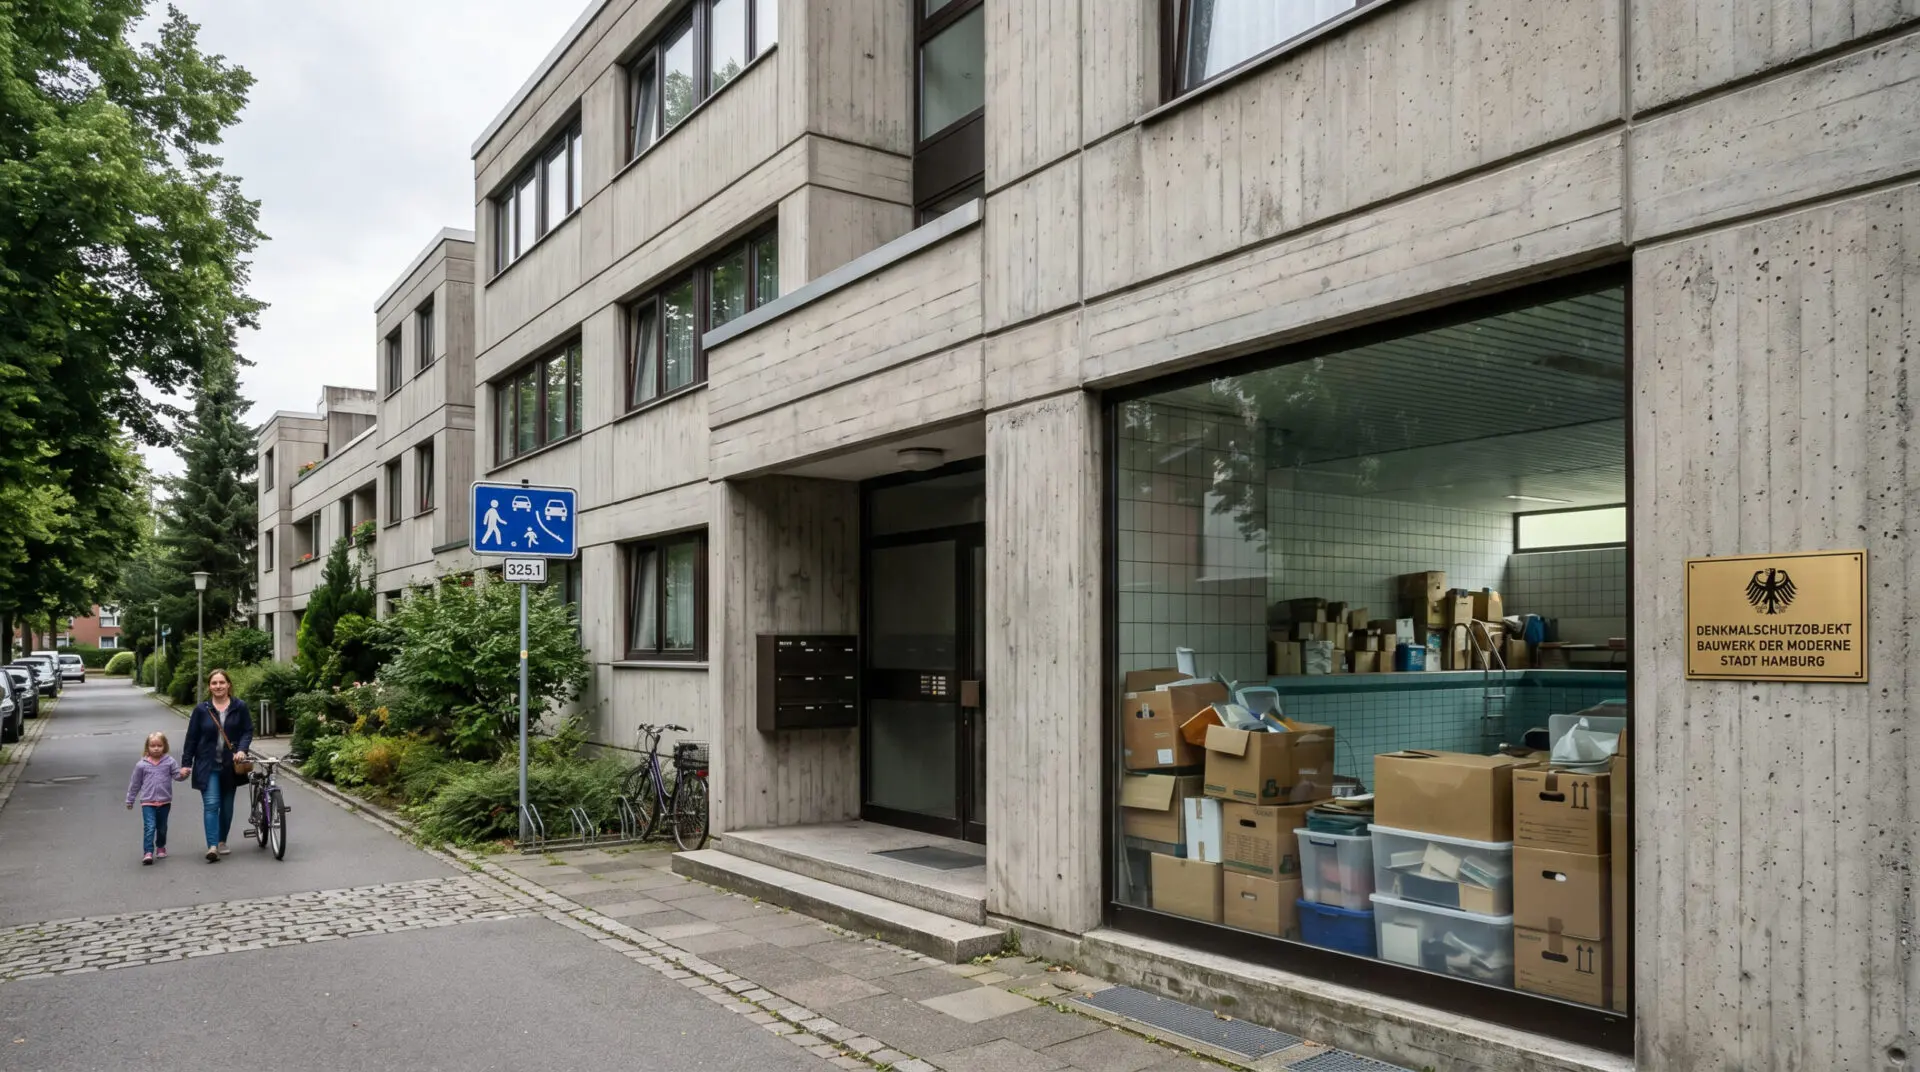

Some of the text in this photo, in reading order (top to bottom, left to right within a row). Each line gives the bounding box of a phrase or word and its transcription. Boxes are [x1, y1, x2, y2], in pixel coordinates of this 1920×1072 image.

[508, 564, 540, 576] 325.1
[1696, 623, 1852, 636] DENKMALSCHUTZOBJEKT
[1697, 640, 1851, 651] BAUWERK DER MODERNE
[1720, 655, 1825, 667] STADT HAMBURG
